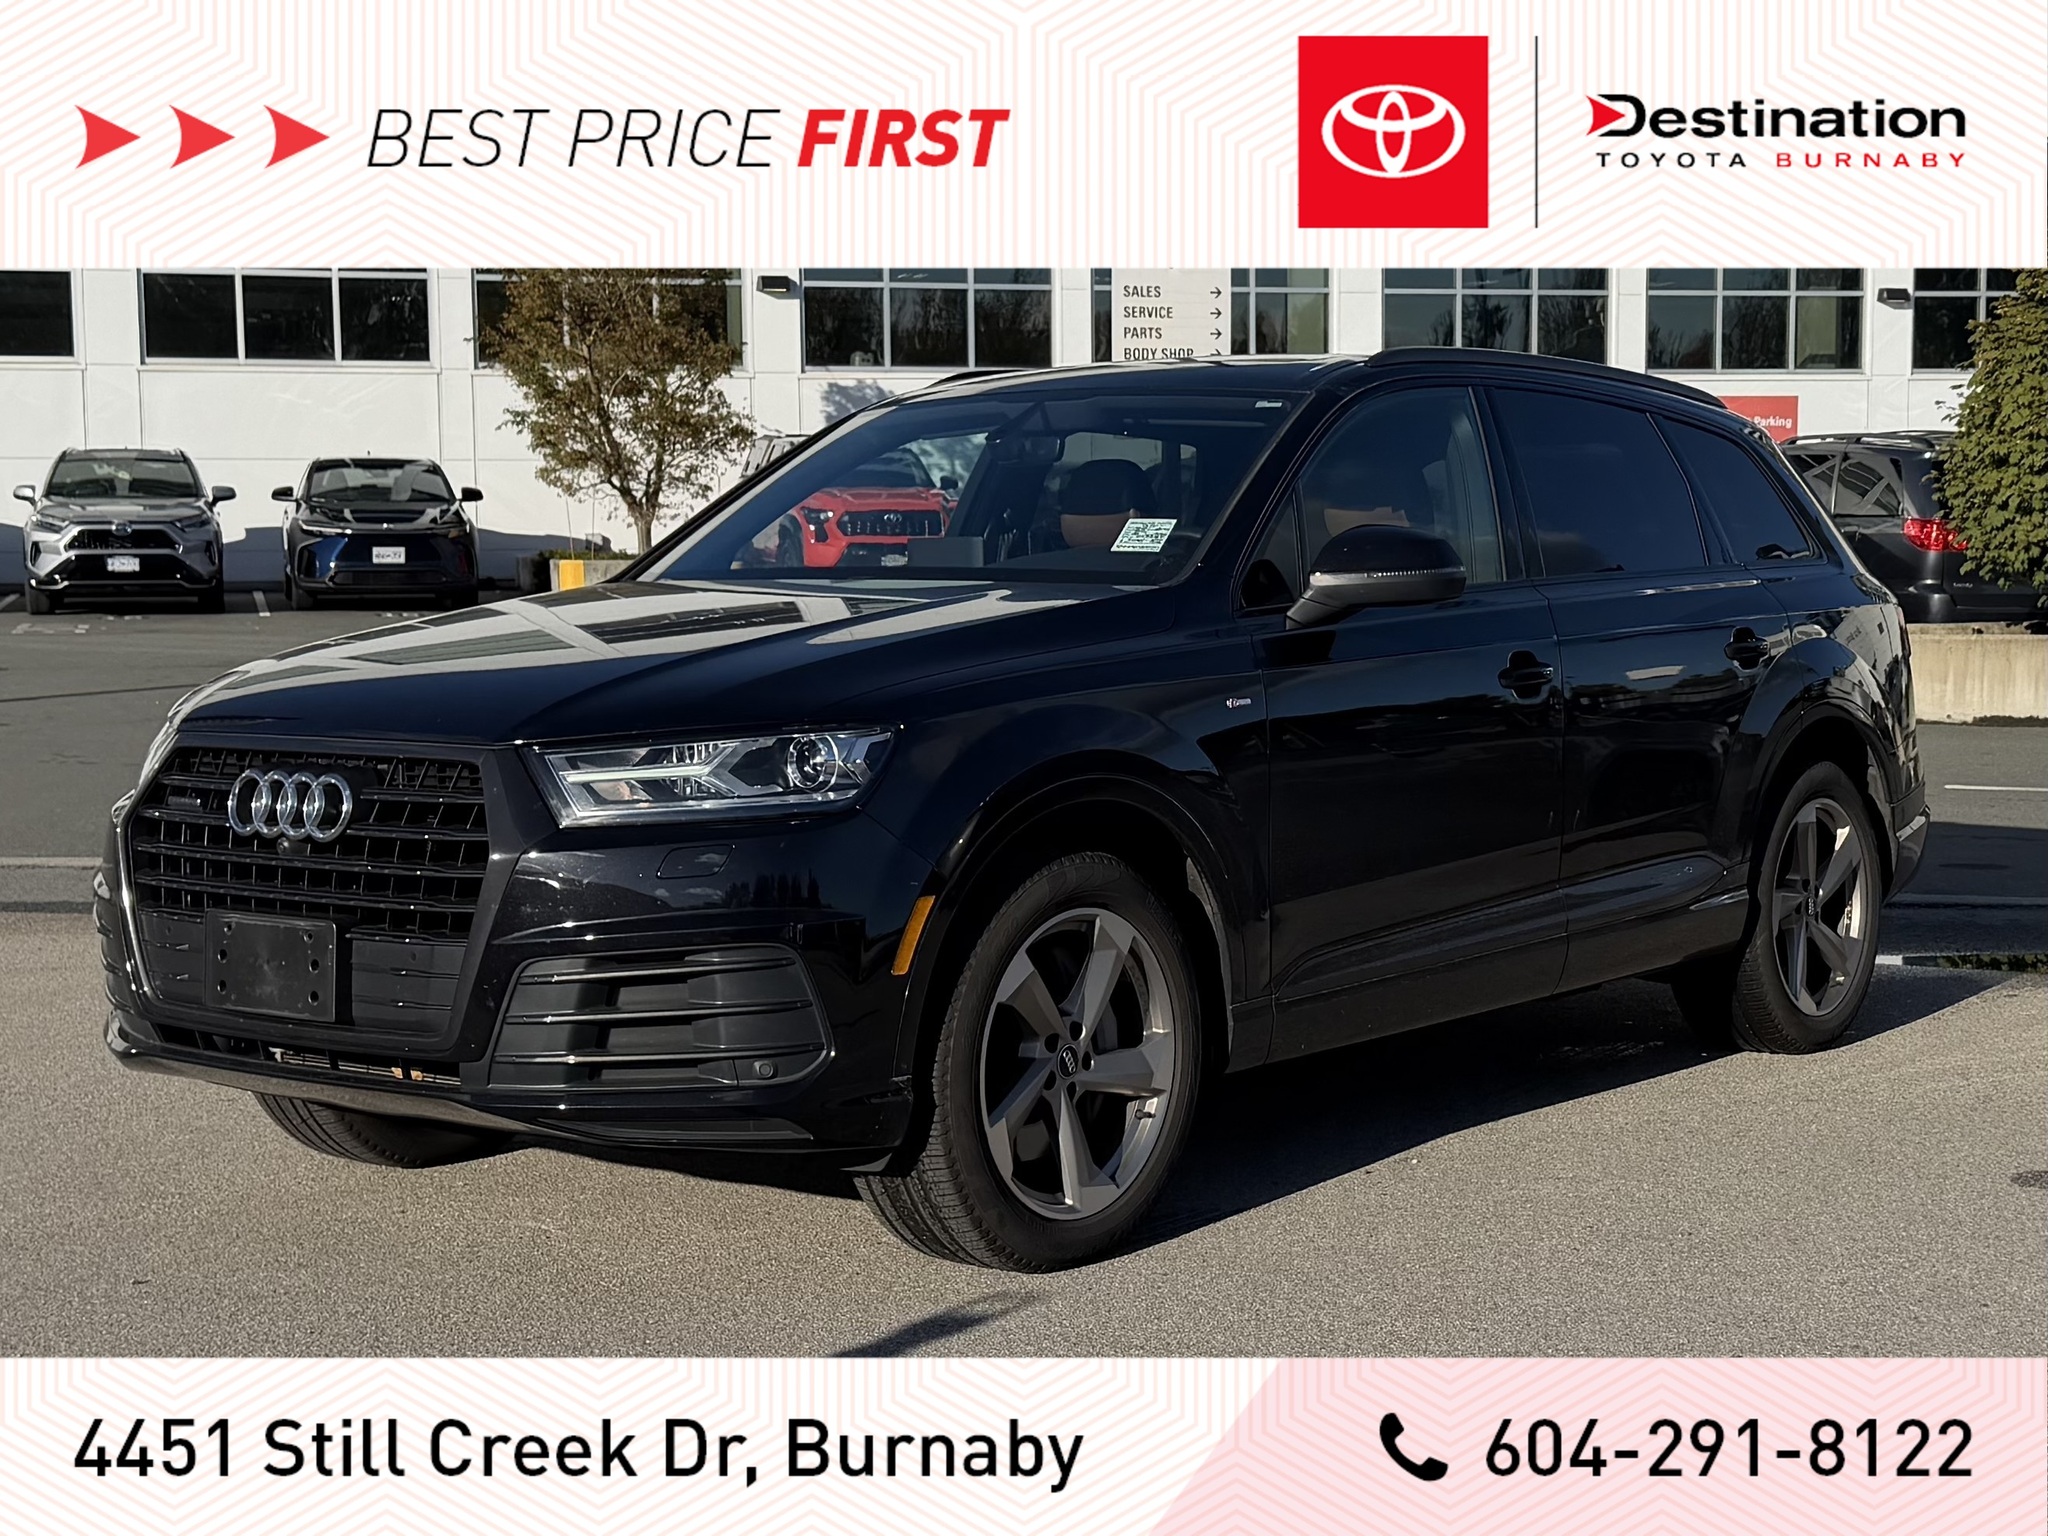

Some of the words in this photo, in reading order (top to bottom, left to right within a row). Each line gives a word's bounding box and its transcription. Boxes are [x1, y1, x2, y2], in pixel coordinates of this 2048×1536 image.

[1123, 284, 1162, 298] SALES
[1123, 305, 1174, 319] SERVICE
[1123, 326, 1163, 340] PARTS
[1123, 347, 1157, 361] BODY
[1161, 347, 1195, 360] SHOP
[1753, 415, 1793, 429] Parking
